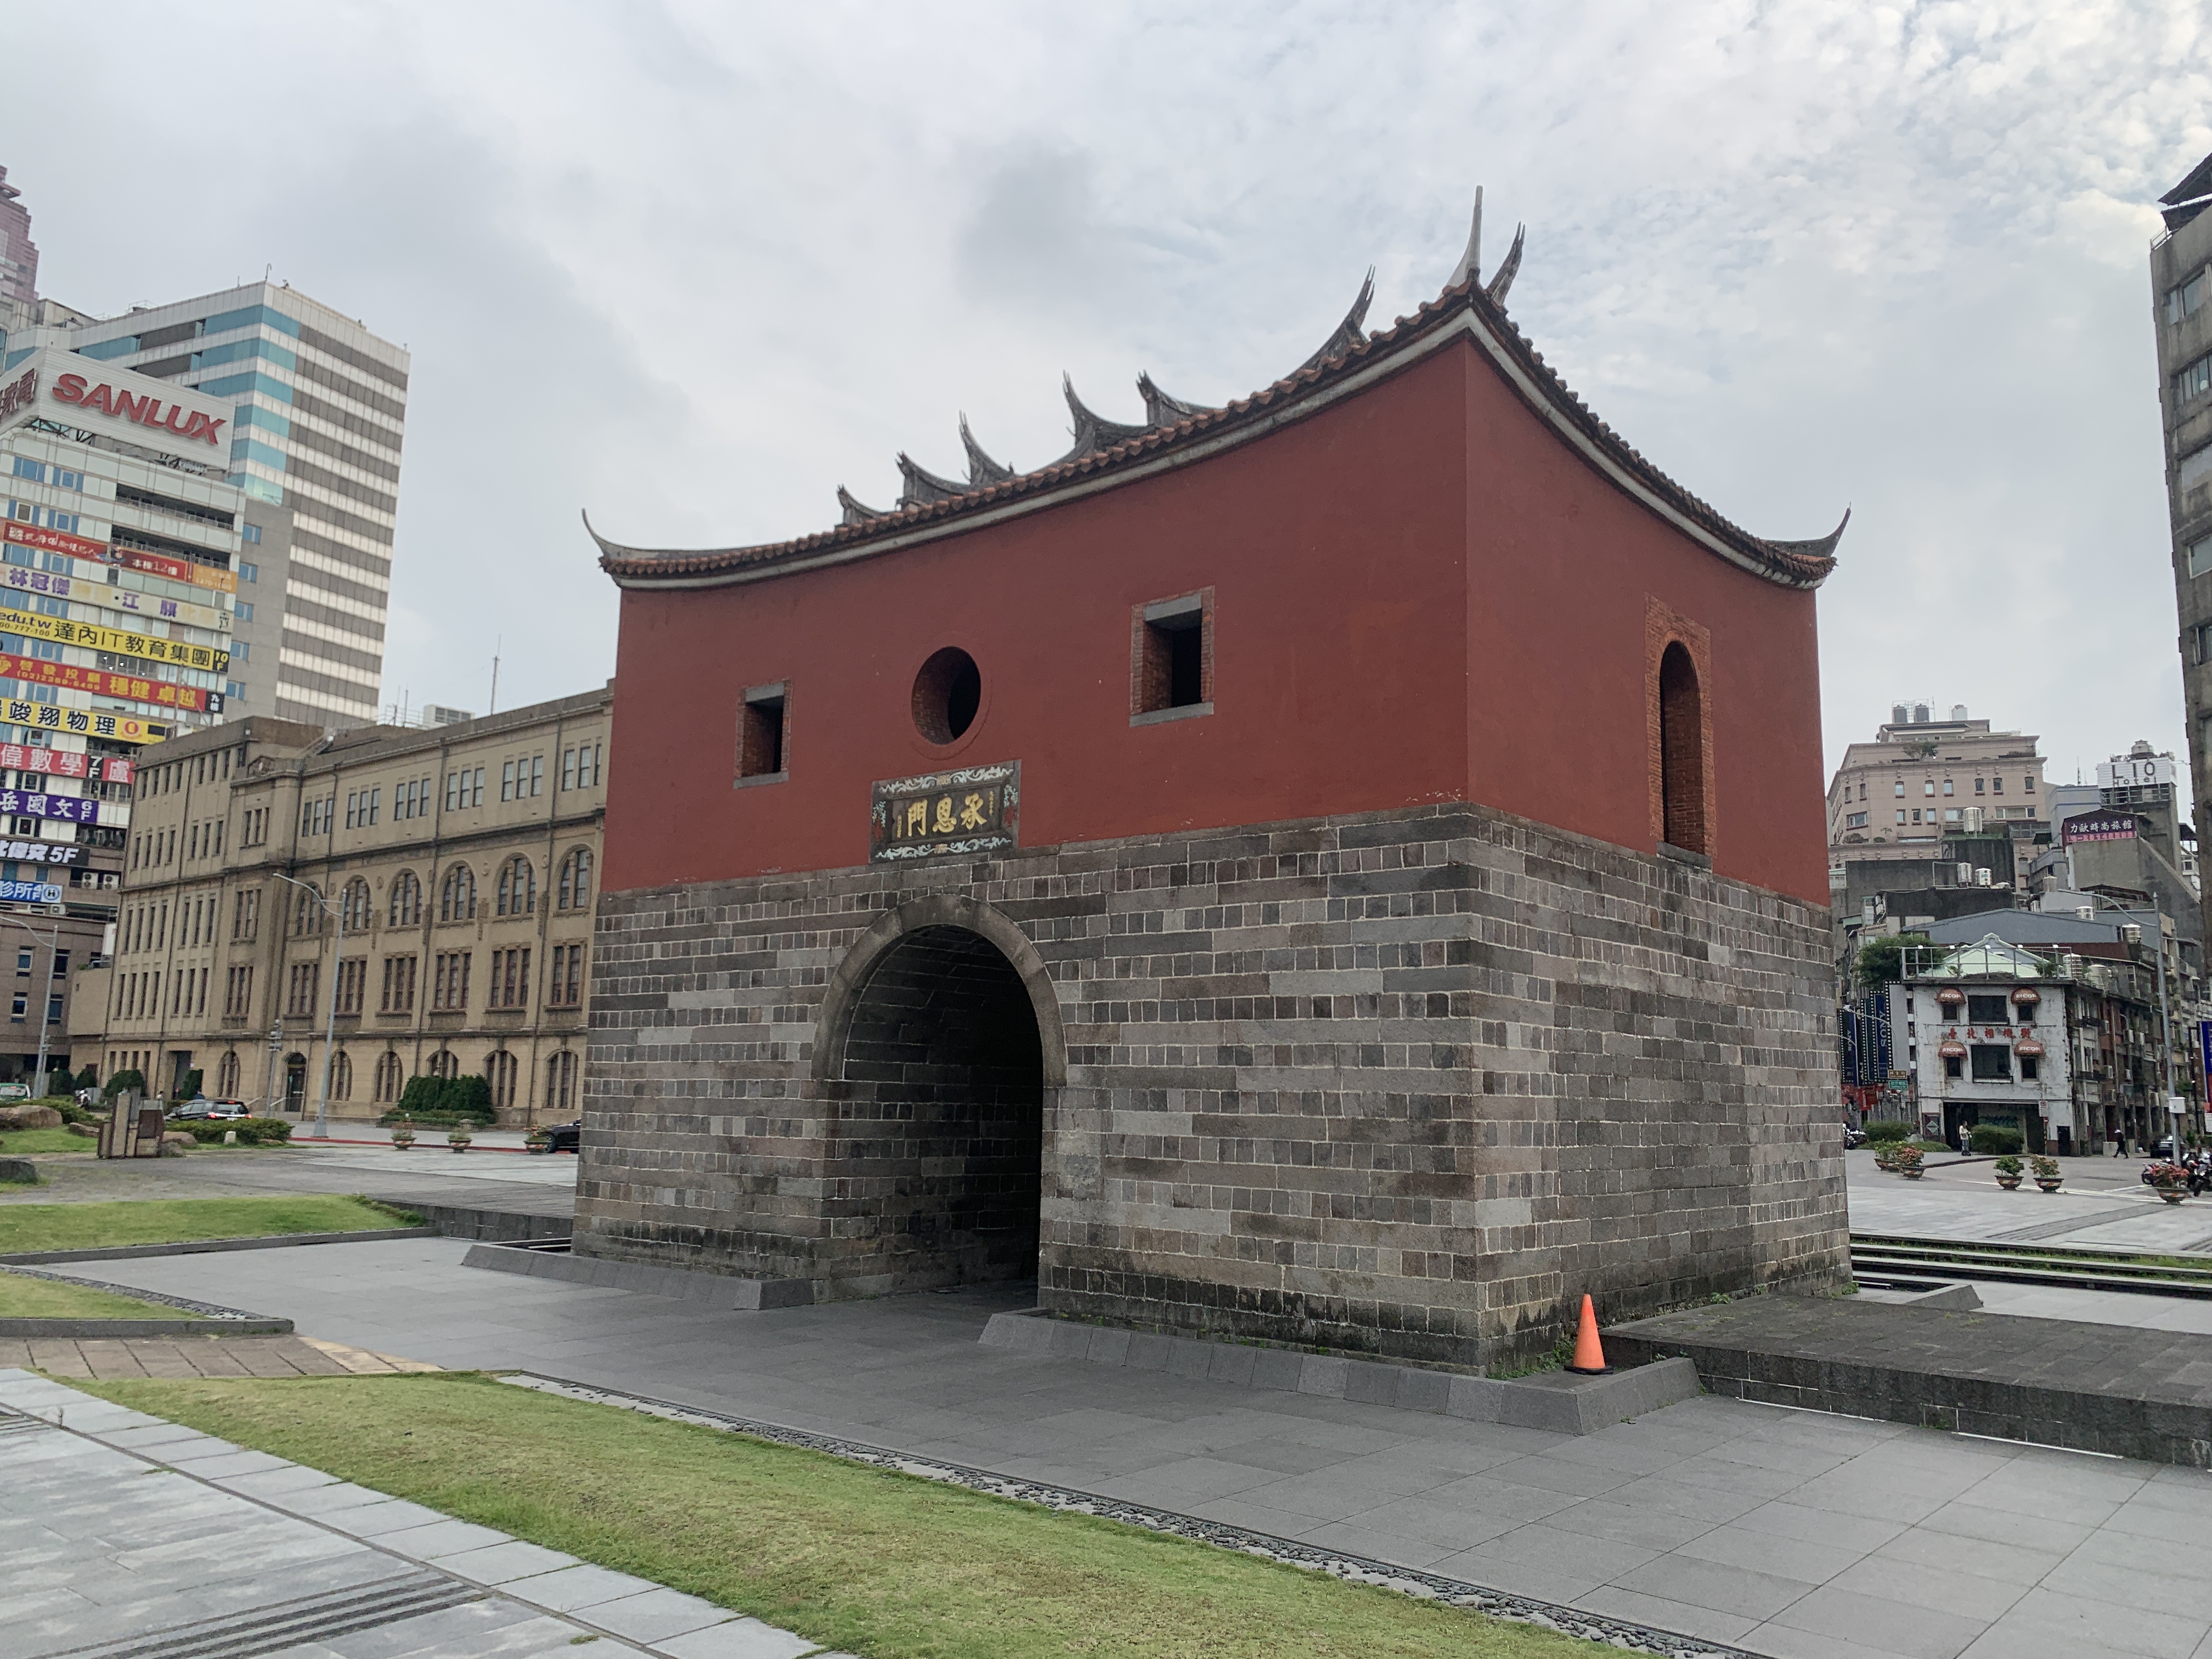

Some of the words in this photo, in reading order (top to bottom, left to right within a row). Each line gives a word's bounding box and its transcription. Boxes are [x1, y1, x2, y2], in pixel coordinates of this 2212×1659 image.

[52, 373, 227, 444] SANLUX
[54, 620, 210, 666] 達內IT教育集團
[9, 701, 115, 735] 竣翔物理
[2112, 761, 2155, 779] LIO
[2113, 776, 2157, 787] Hotel
[907, 792, 988, 837] 承恩門
[2070, 820, 2132, 833] 力歐時尚旅館
[48, 846, 80, 864] 5F
[1879, 1009, 1887, 1047] SONY
